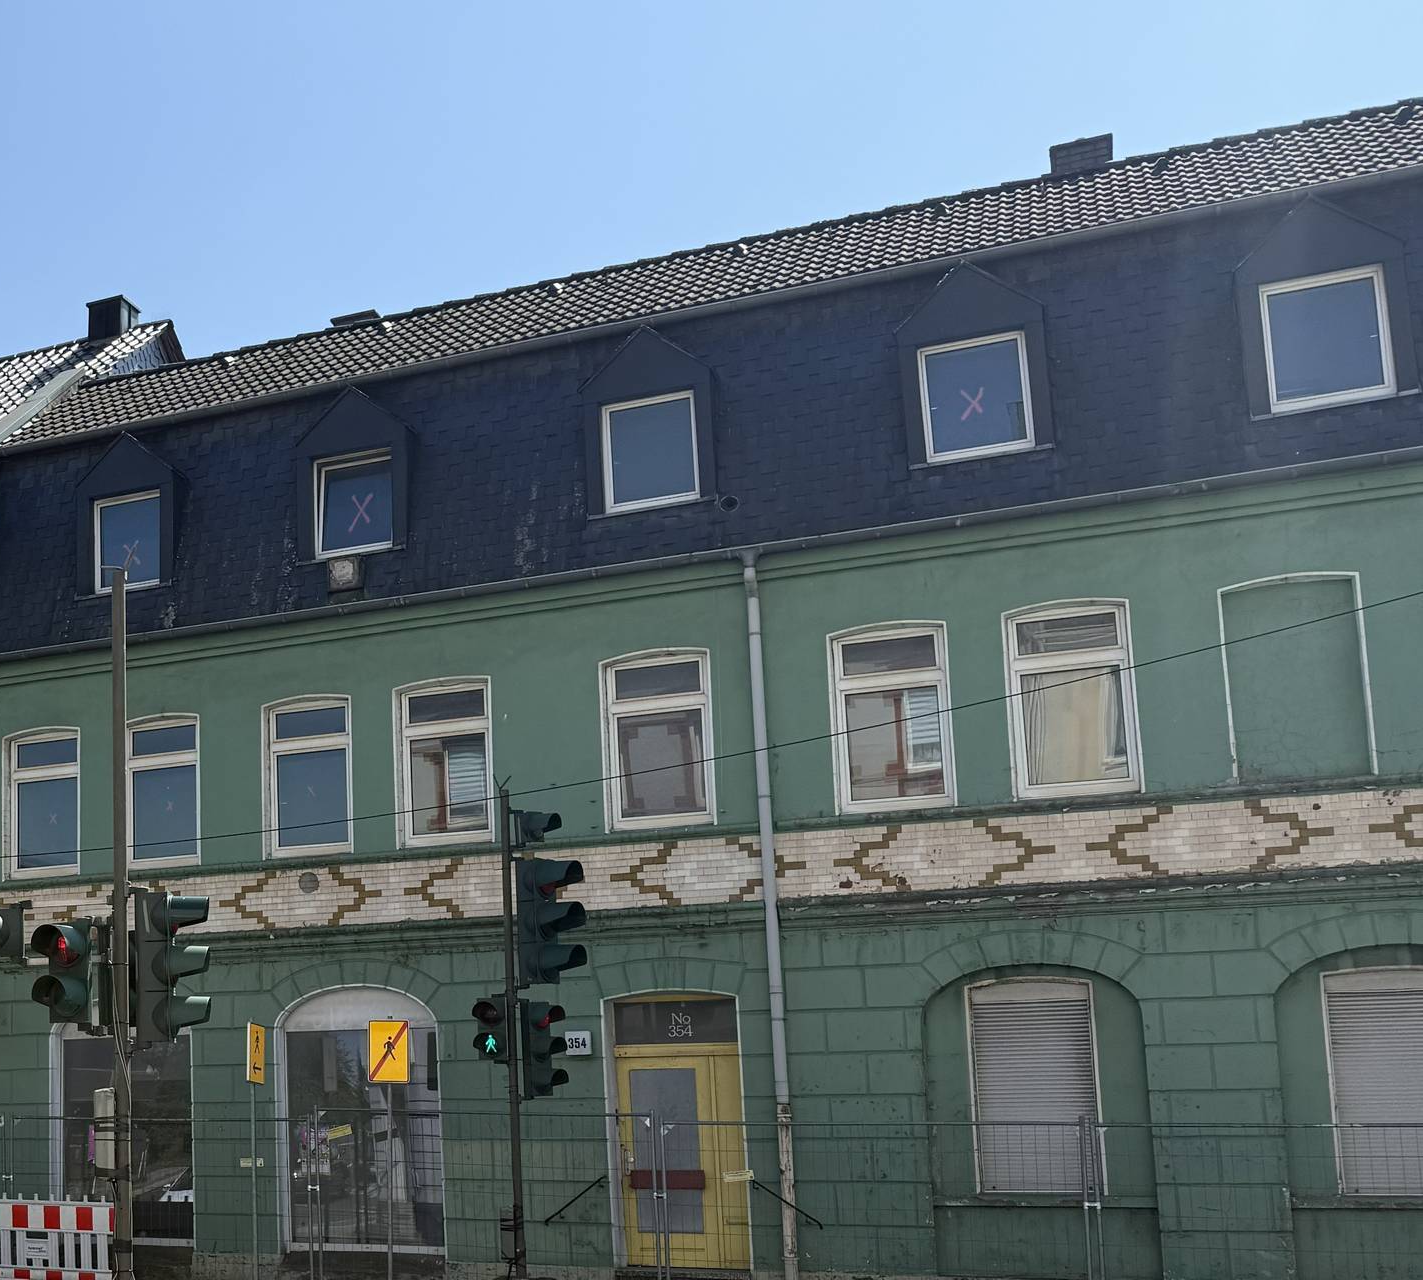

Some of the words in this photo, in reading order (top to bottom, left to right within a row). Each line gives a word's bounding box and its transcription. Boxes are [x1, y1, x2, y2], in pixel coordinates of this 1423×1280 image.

[671, 1012, 691, 1024] No
[667, 1025, 693, 1038] 354
[567, 1037, 587, 1049] 354
